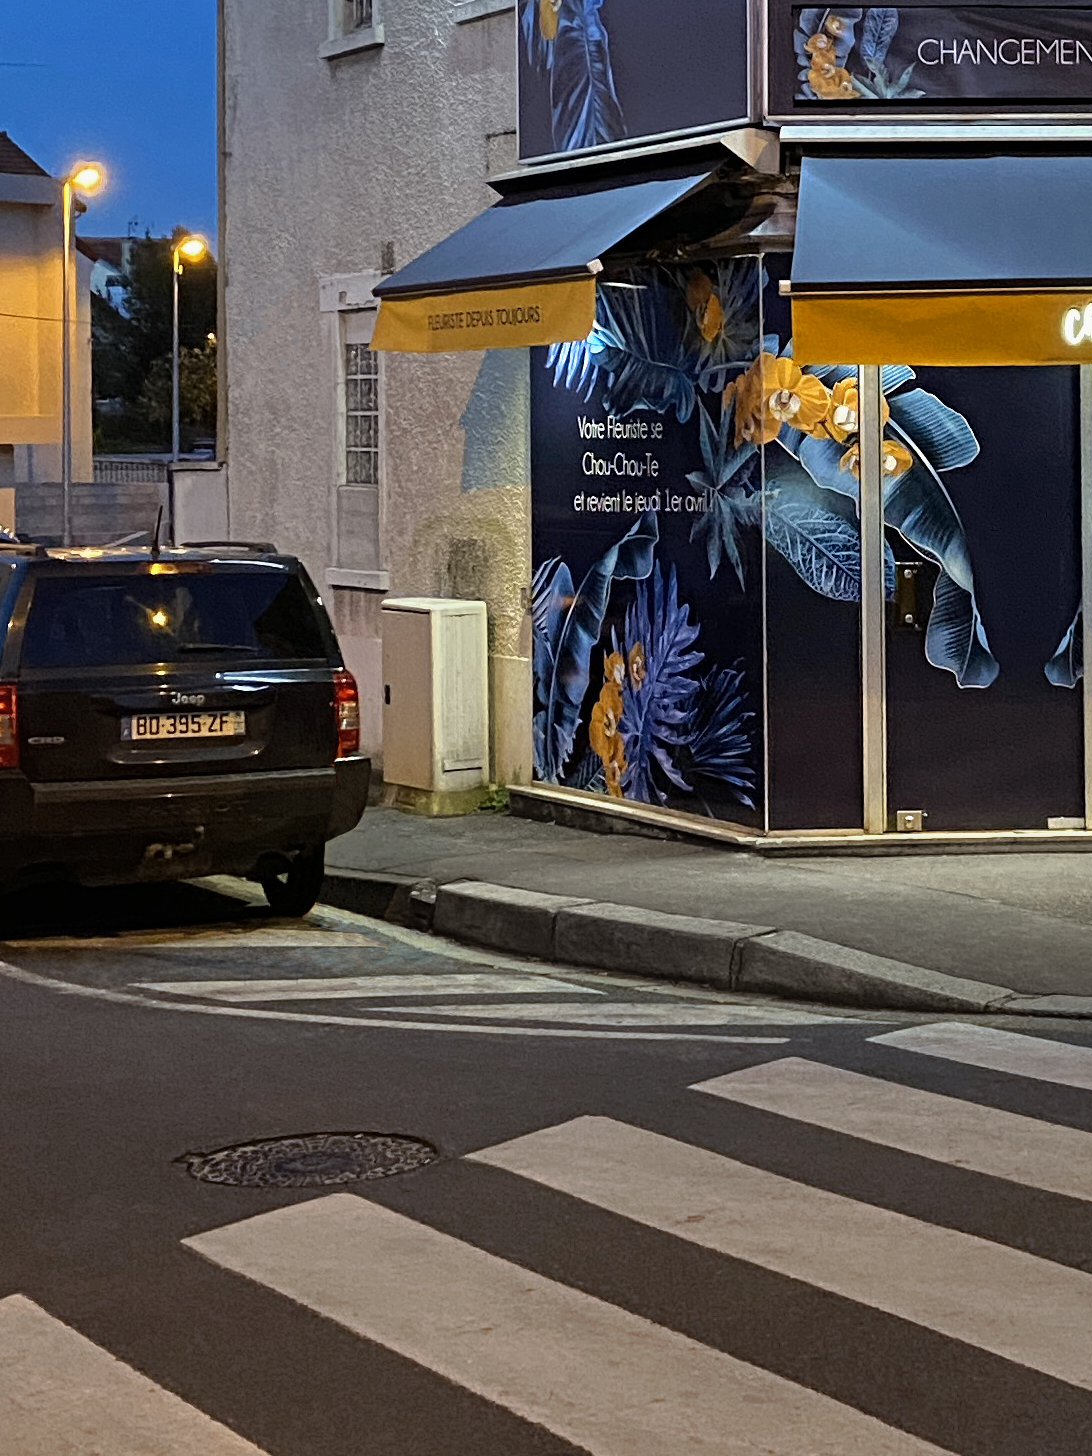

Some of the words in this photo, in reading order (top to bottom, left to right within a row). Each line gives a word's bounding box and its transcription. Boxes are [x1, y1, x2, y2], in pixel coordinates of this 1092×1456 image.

[428, 311, 464, 331] FLEURISTE
[465, 309, 494, 328] DEPUIS
[495, 305, 540, 326] TOUJOURS
[577, 414, 605, 439] Votre
[607, 414, 648, 439] Fleuriste
[650, 421, 664, 440] se
[582, 451, 659, 477] Chou-Chou-Te
[573, 490, 585, 512] et
[586, 491, 620, 513] revient
[622, 488, 633, 512] le
[634, 487, 661, 514] jeudi
[664, 487, 682, 512] 1er
[171, 692, 205, 706] Jeep
